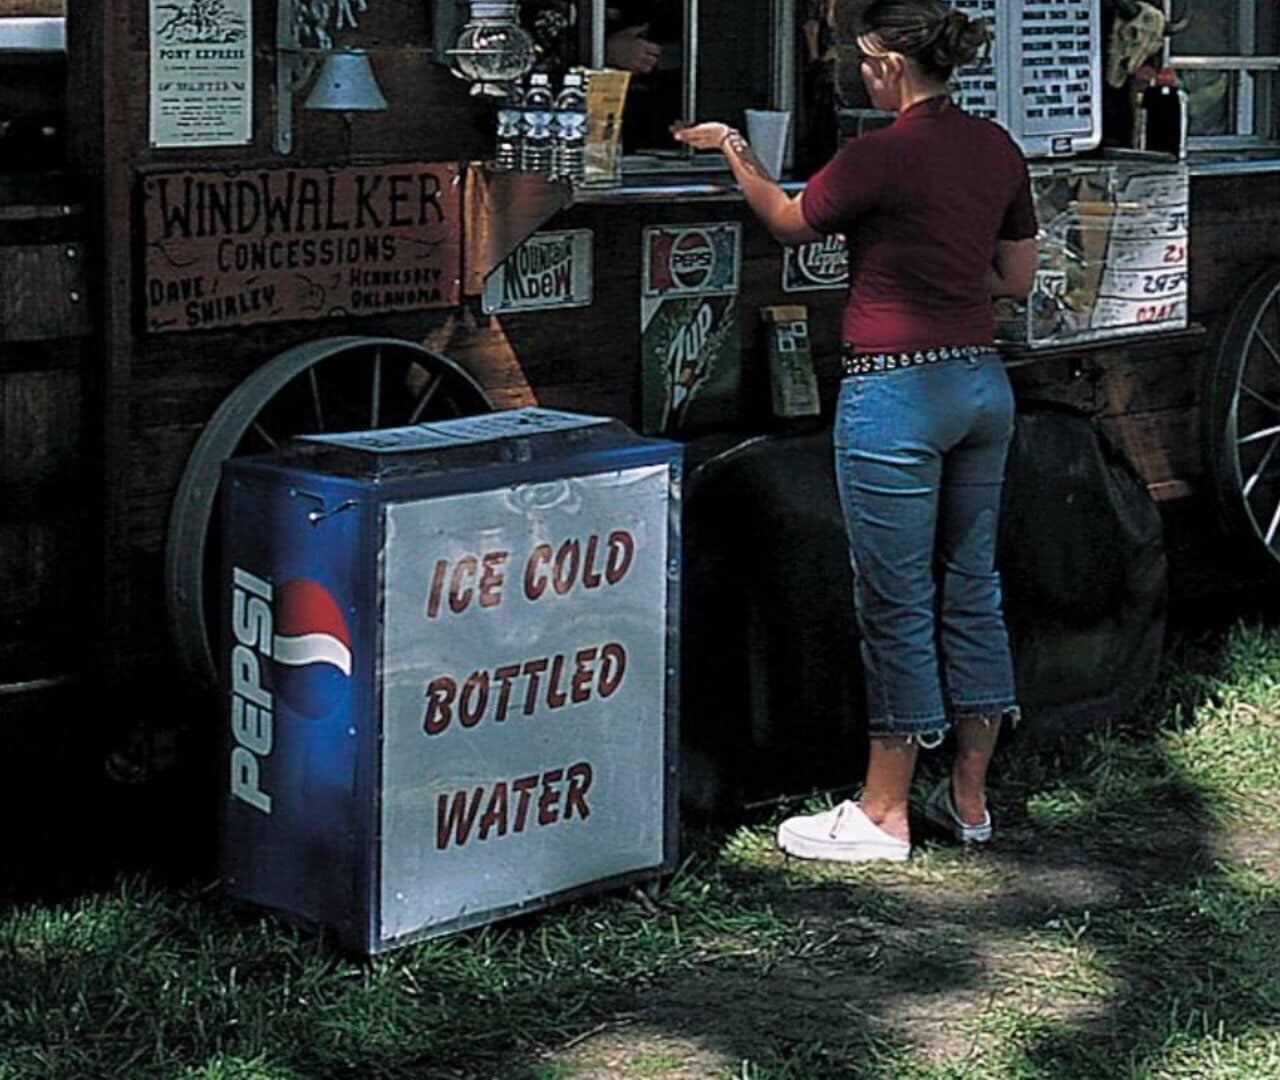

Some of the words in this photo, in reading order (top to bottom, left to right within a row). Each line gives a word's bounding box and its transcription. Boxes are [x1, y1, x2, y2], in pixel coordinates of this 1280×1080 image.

[157, 170, 445, 238] WINDWALKER
[218, 234, 397, 272] CONCESSIONS
[426, 551, 508, 618] ICE
[524, 530, 634, 601] COLD
[231, 565, 274, 814] PEPSI
[423, 642, 627, 735] BOTTLED
[435, 761, 593, 851] WATER
